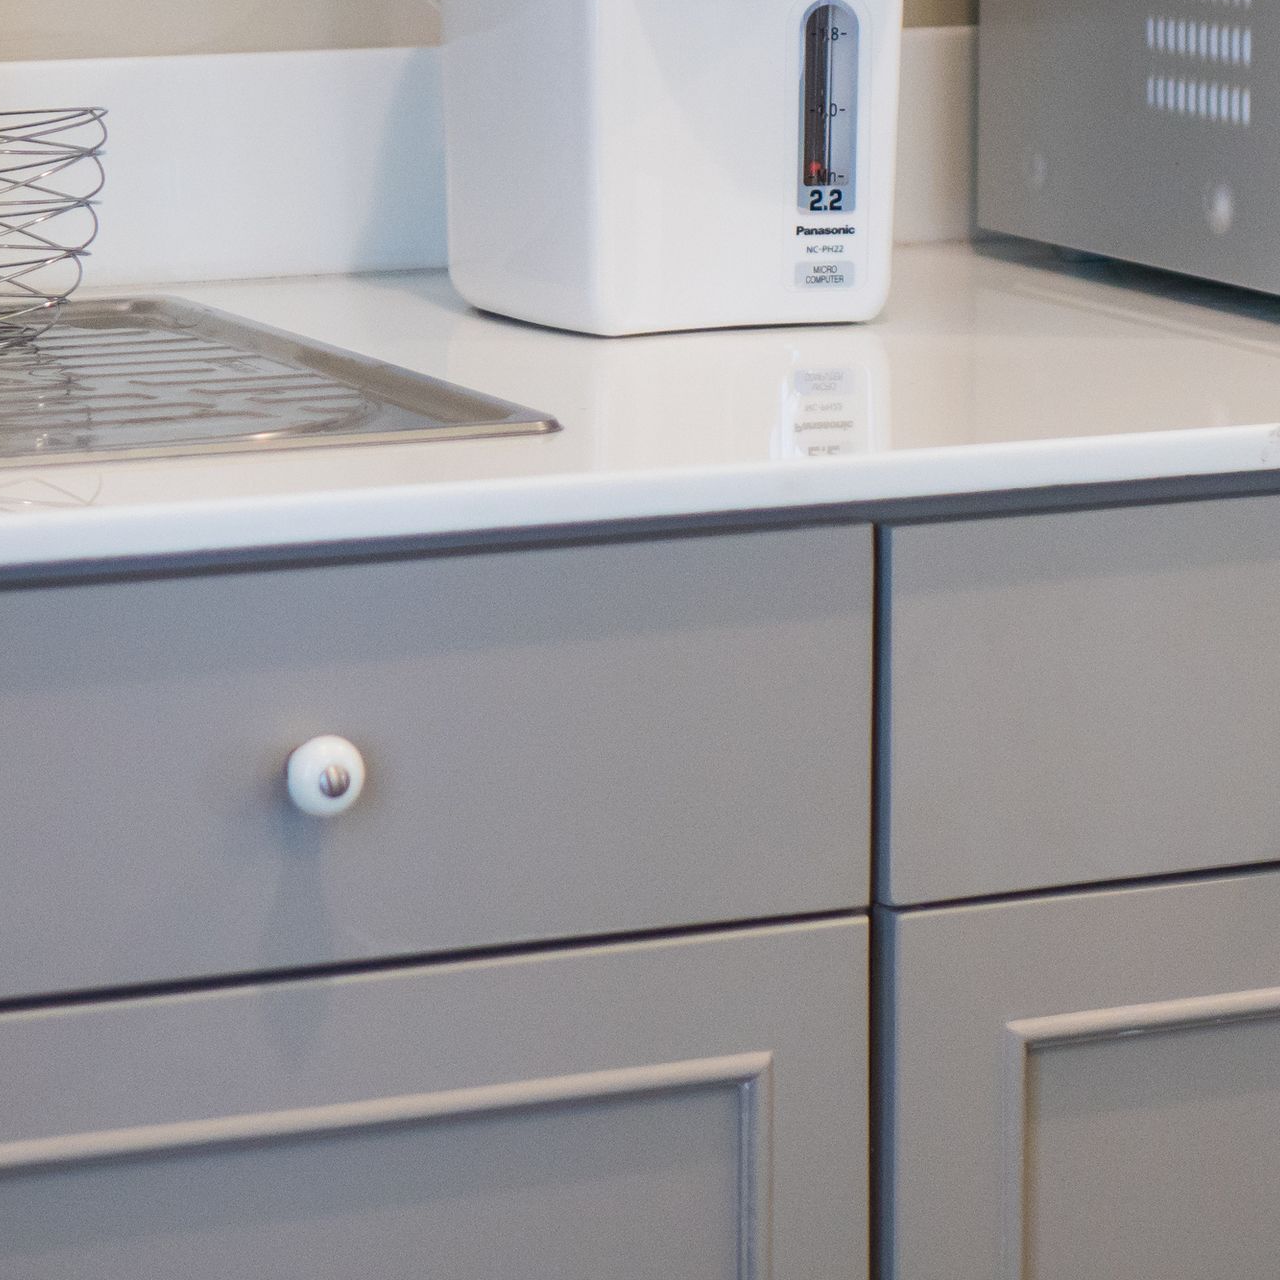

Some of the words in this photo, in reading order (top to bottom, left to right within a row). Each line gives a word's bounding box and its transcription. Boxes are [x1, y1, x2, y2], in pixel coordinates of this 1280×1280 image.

[809, 188, 843, 212] 2.2
[795, 224, 856, 236] Panasonic
[806, 244, 844, 254] NC-PH22
[813, 265, 838, 274] MICRO
[805, 275, 845, 285] COMPUTER
